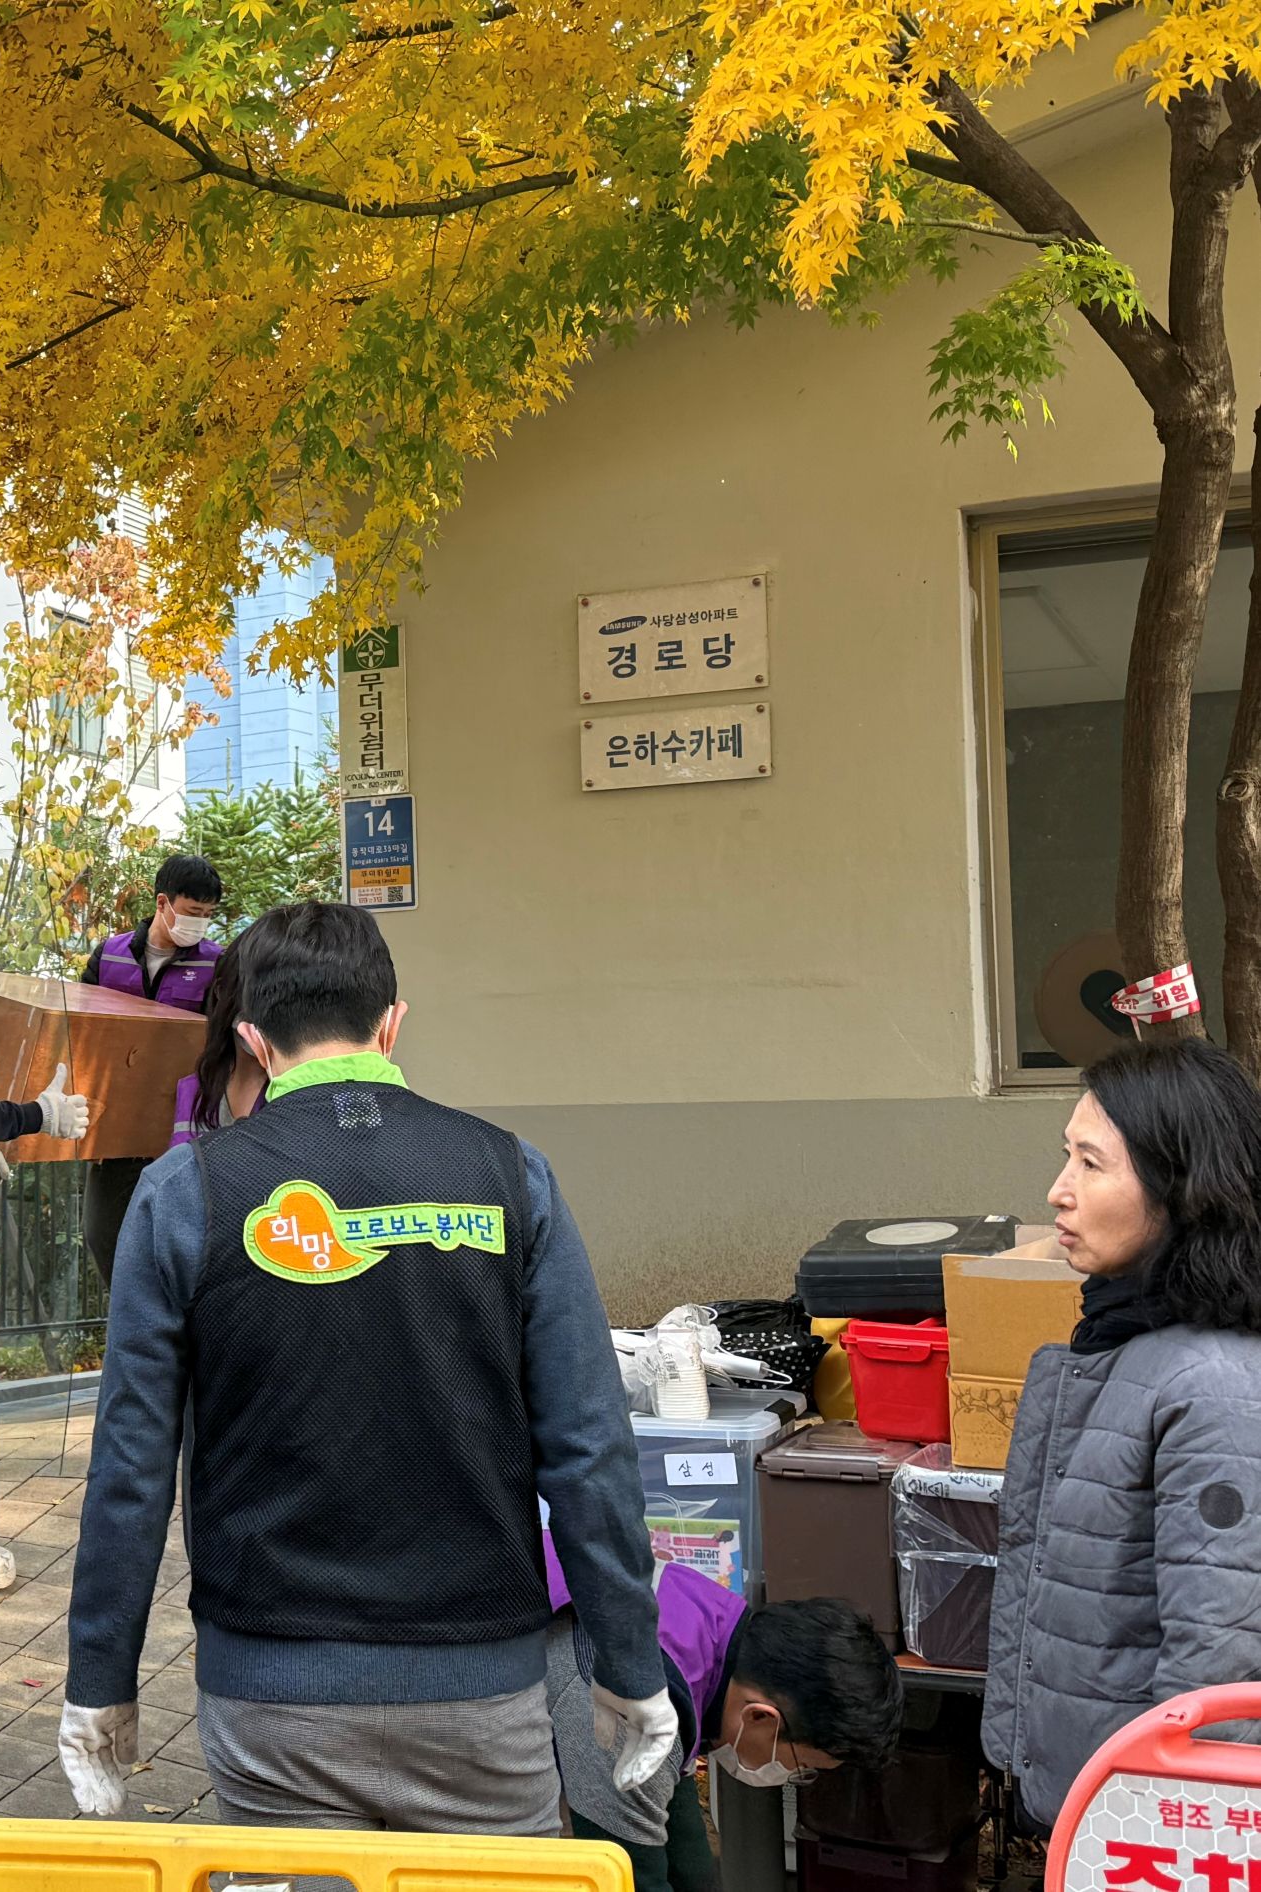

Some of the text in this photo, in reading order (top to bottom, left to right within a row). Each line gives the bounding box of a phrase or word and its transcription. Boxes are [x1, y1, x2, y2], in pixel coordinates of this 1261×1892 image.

[649, 607, 739, 628] 사당삼성아파트
[607, 633, 735, 678] 경로당
[357, 672, 384, 770] 무더위쉼터
[606, 723, 742, 768] 은하수카페
[364, 810, 395, 837] 14
[1152, 982, 1189, 1008] 위험
[269, 1213, 494, 1269] 희망 프로보노봉사단
[1158, 1799, 1261, 1837] 협조 부
